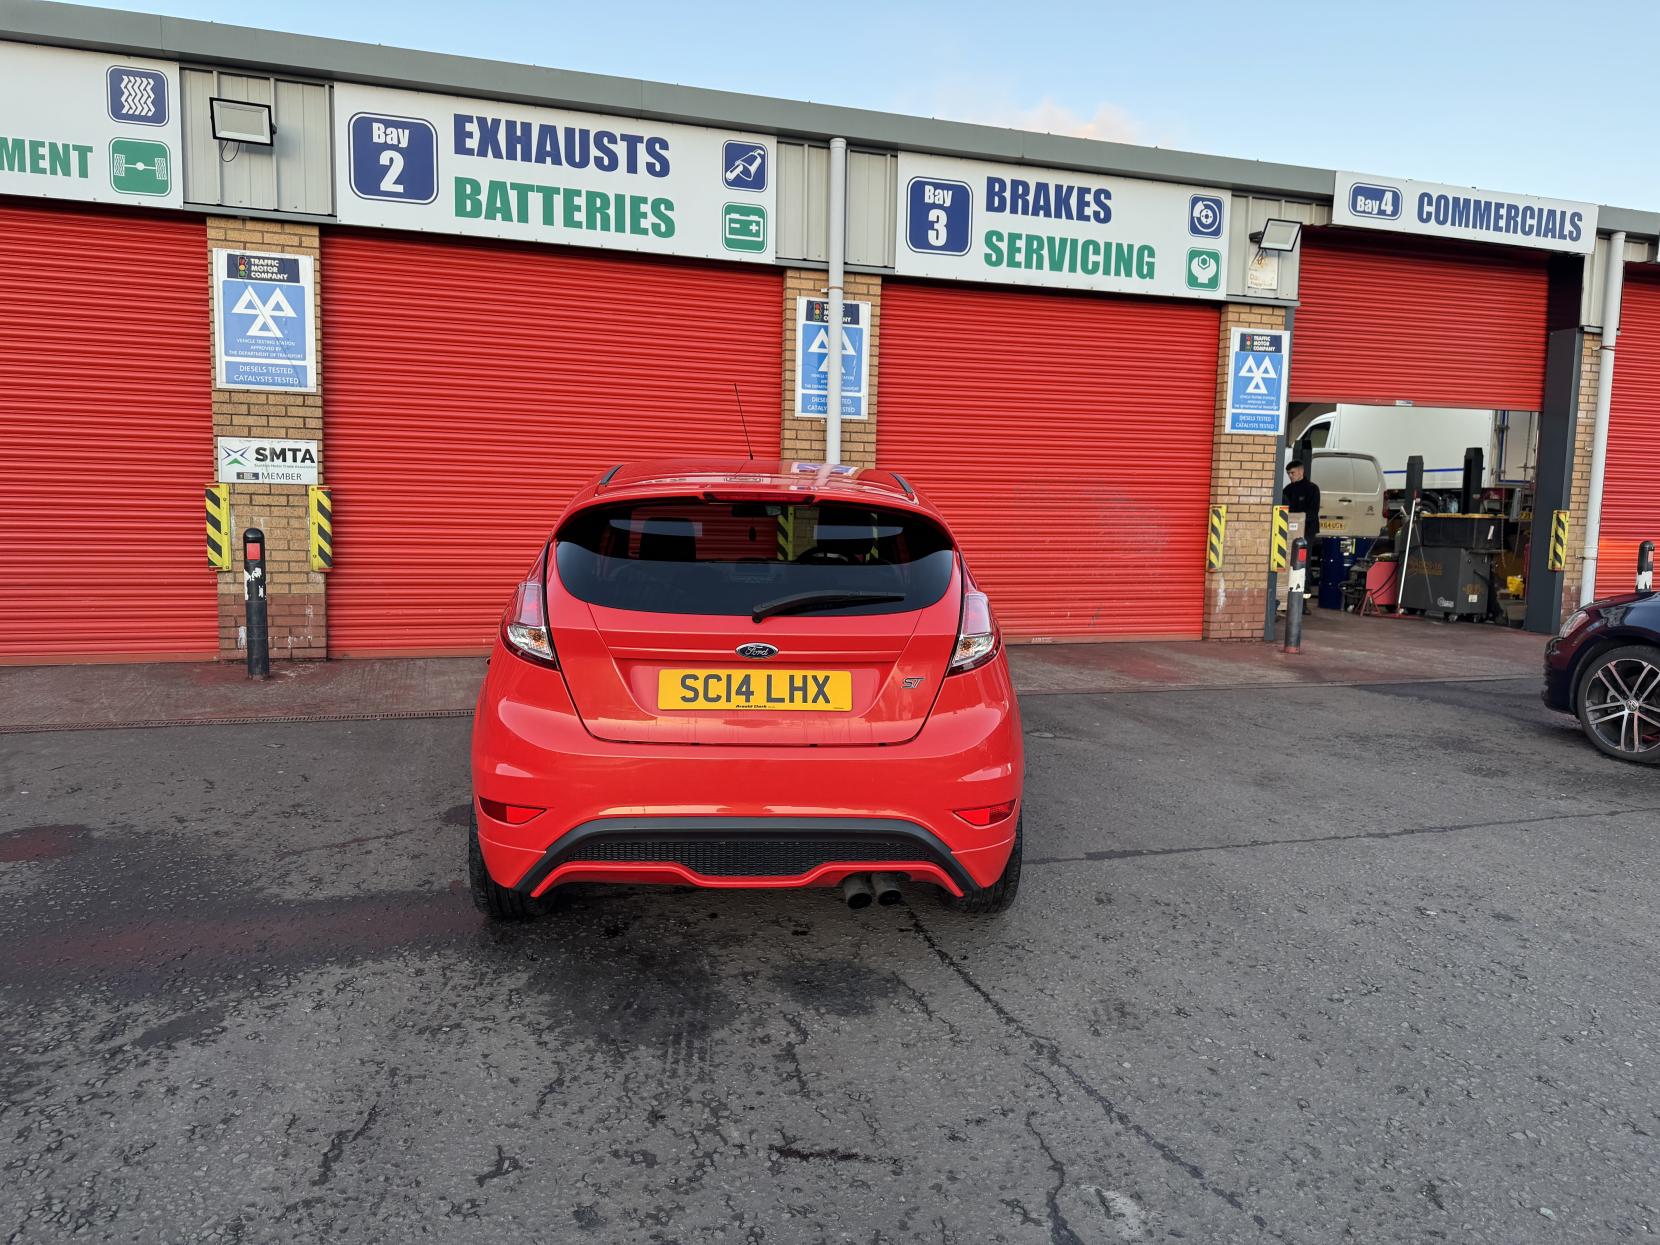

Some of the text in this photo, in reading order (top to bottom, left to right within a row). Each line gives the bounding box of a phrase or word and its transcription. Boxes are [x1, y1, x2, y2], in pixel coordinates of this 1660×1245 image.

[372, 122, 409, 148] Bay
[453, 113, 670, 178] EXHAUSTS
[0, 136, 94, 179] MENT
[379, 150, 405, 193] 2
[454, 176, 676, 239] BATTERIES
[924, 185, 952, 207] Bay
[985, 175, 1113, 225] BRAKES
[1356, 191, 1394, 215] Bay 4
[927, 208, 948, 247] 3
[1417, 191, 1583, 242] COMMERCIALS
[250, 258, 279, 267] TRAFFIC
[983, 229, 1156, 280] SERVICING
[250, 265, 278, 273] MOTOR
[250, 271, 288, 280] COMPANY
[234, 374, 299, 384] CATALYSTS TESTED
[239, 365, 267, 373] DIESELS
[254, 446, 316, 464] SMTA
[261, 472, 302, 480] MEMBER
[744, 645, 769, 656] Ford
[680, 673, 831, 704] SC14 LHX
[901, 677, 926, 689] ST
